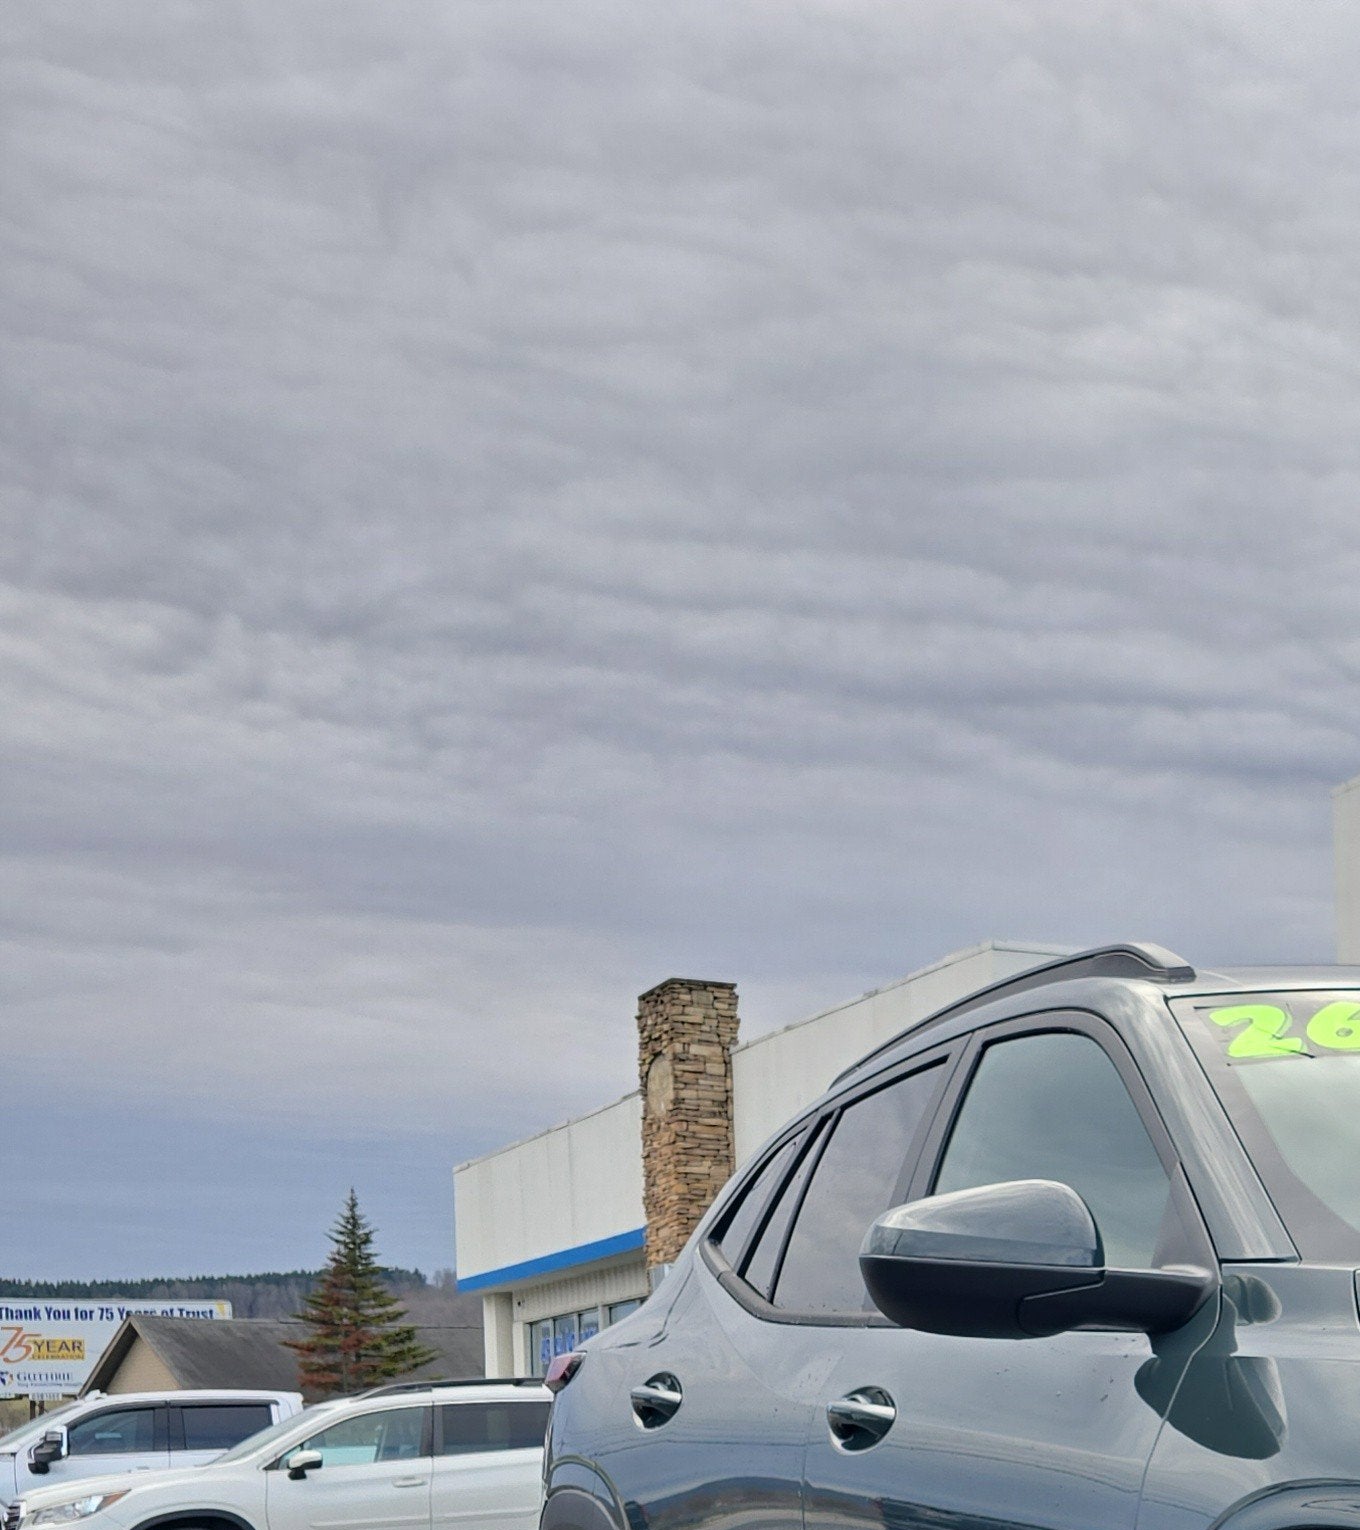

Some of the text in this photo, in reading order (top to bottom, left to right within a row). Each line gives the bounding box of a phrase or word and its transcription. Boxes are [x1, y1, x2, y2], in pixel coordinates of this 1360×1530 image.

[0, 1305, 41, 1321] Thank
[45, 1306, 71, 1321] You
[74, 1306, 95, 1321] for
[98, 1307, 114, 1321] 75
[178, 1308, 214, 1320] Trust
[0, 1327, 41, 1363] 75
[33, 1340, 83, 1352] YEAR
